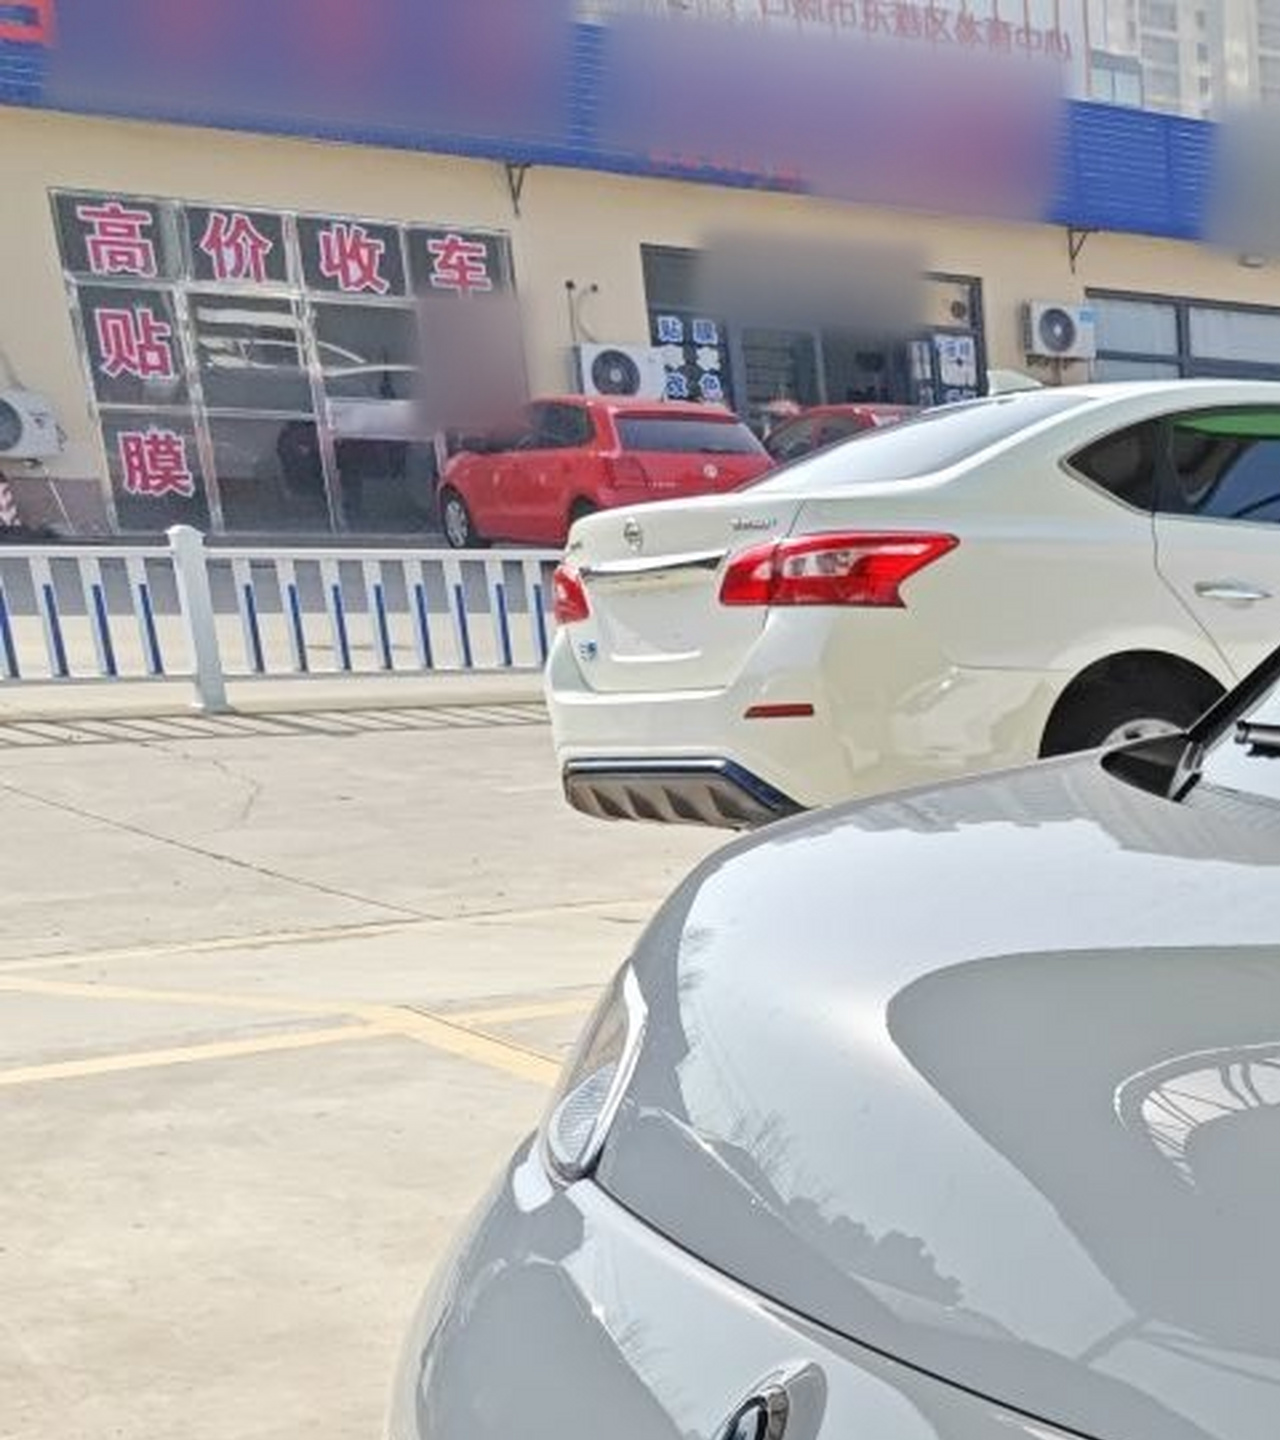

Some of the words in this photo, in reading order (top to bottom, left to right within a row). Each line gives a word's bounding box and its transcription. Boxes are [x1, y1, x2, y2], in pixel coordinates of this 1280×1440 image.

[77, 203, 493, 294] 高价收车
[95, 306, 196, 499] 贴膜
